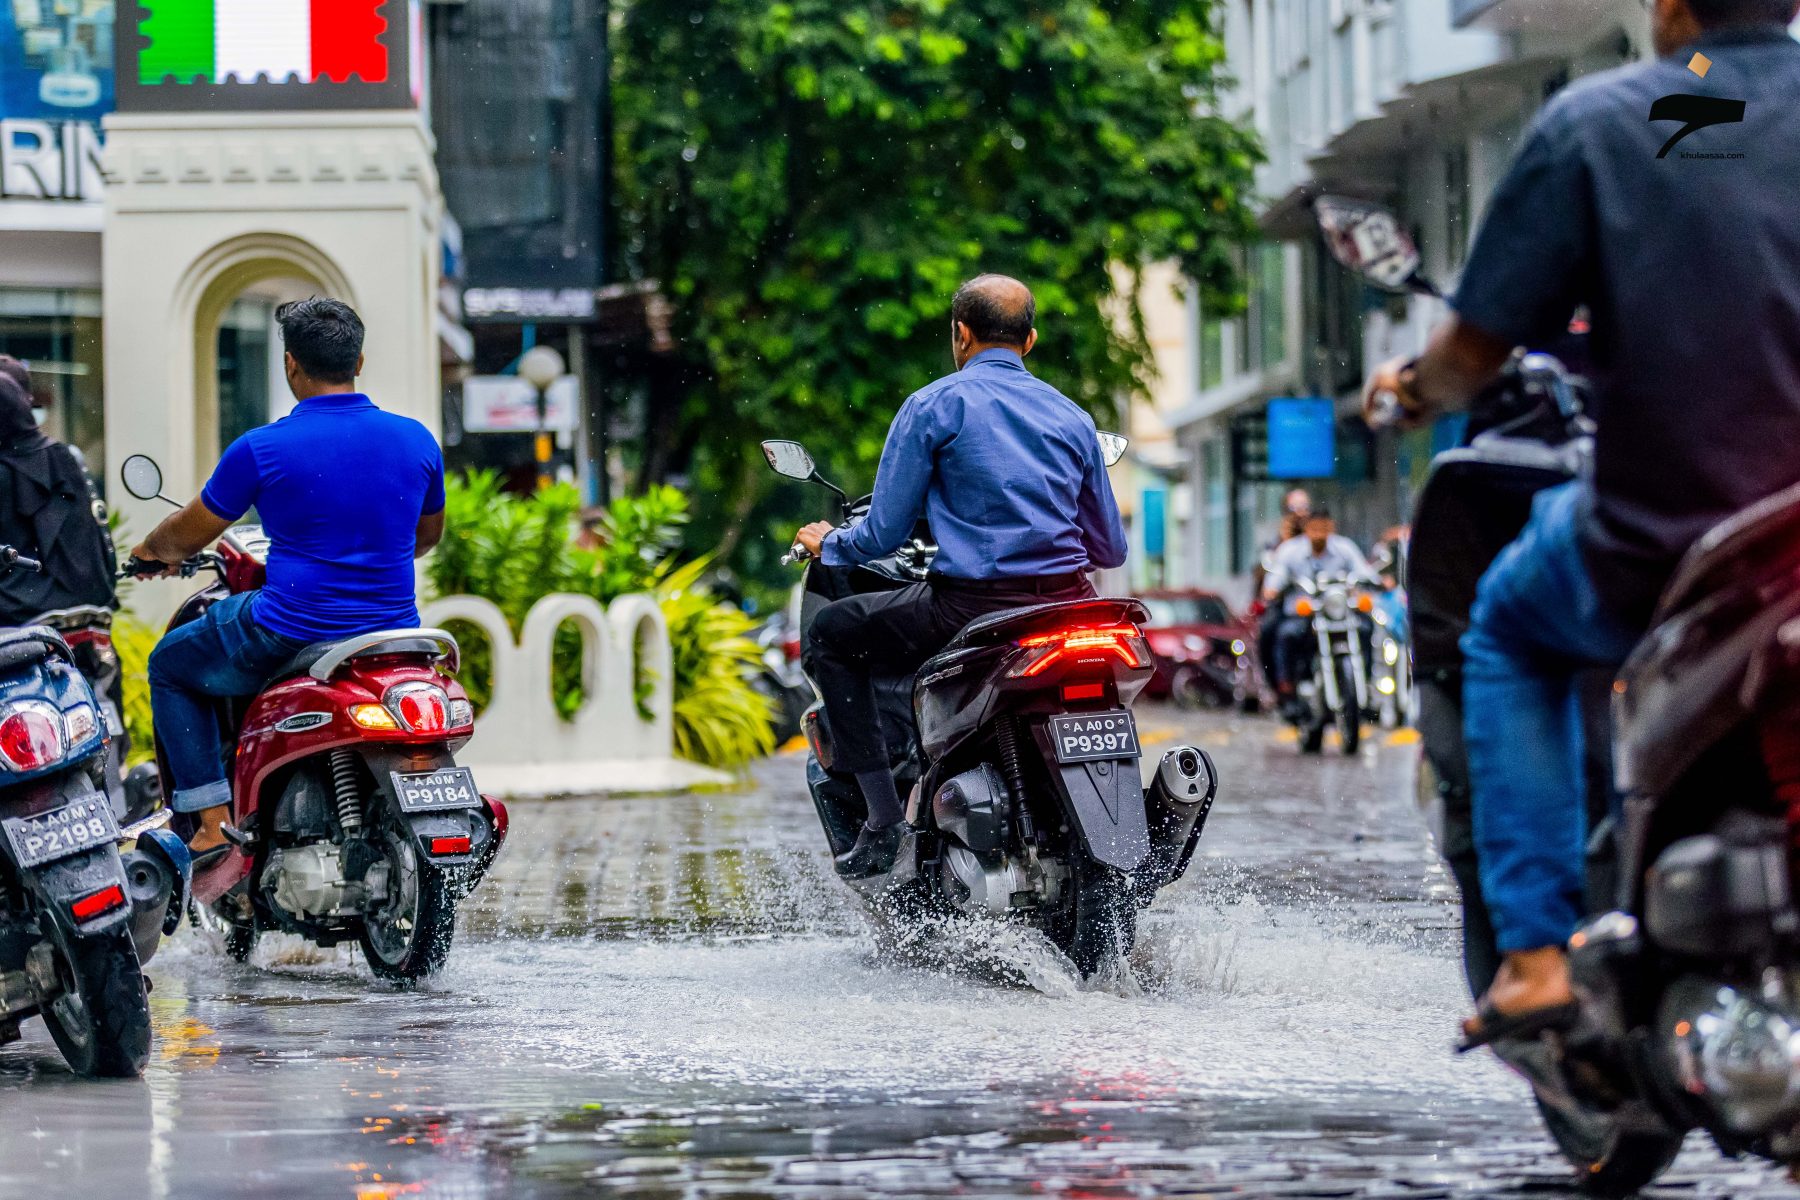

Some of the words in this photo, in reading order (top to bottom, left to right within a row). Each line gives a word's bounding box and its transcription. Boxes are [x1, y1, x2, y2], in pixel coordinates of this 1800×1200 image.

[1063, 732, 1129, 754] P9397
[405, 785, 470, 805] P9184
[25, 818, 105, 857] P2198
